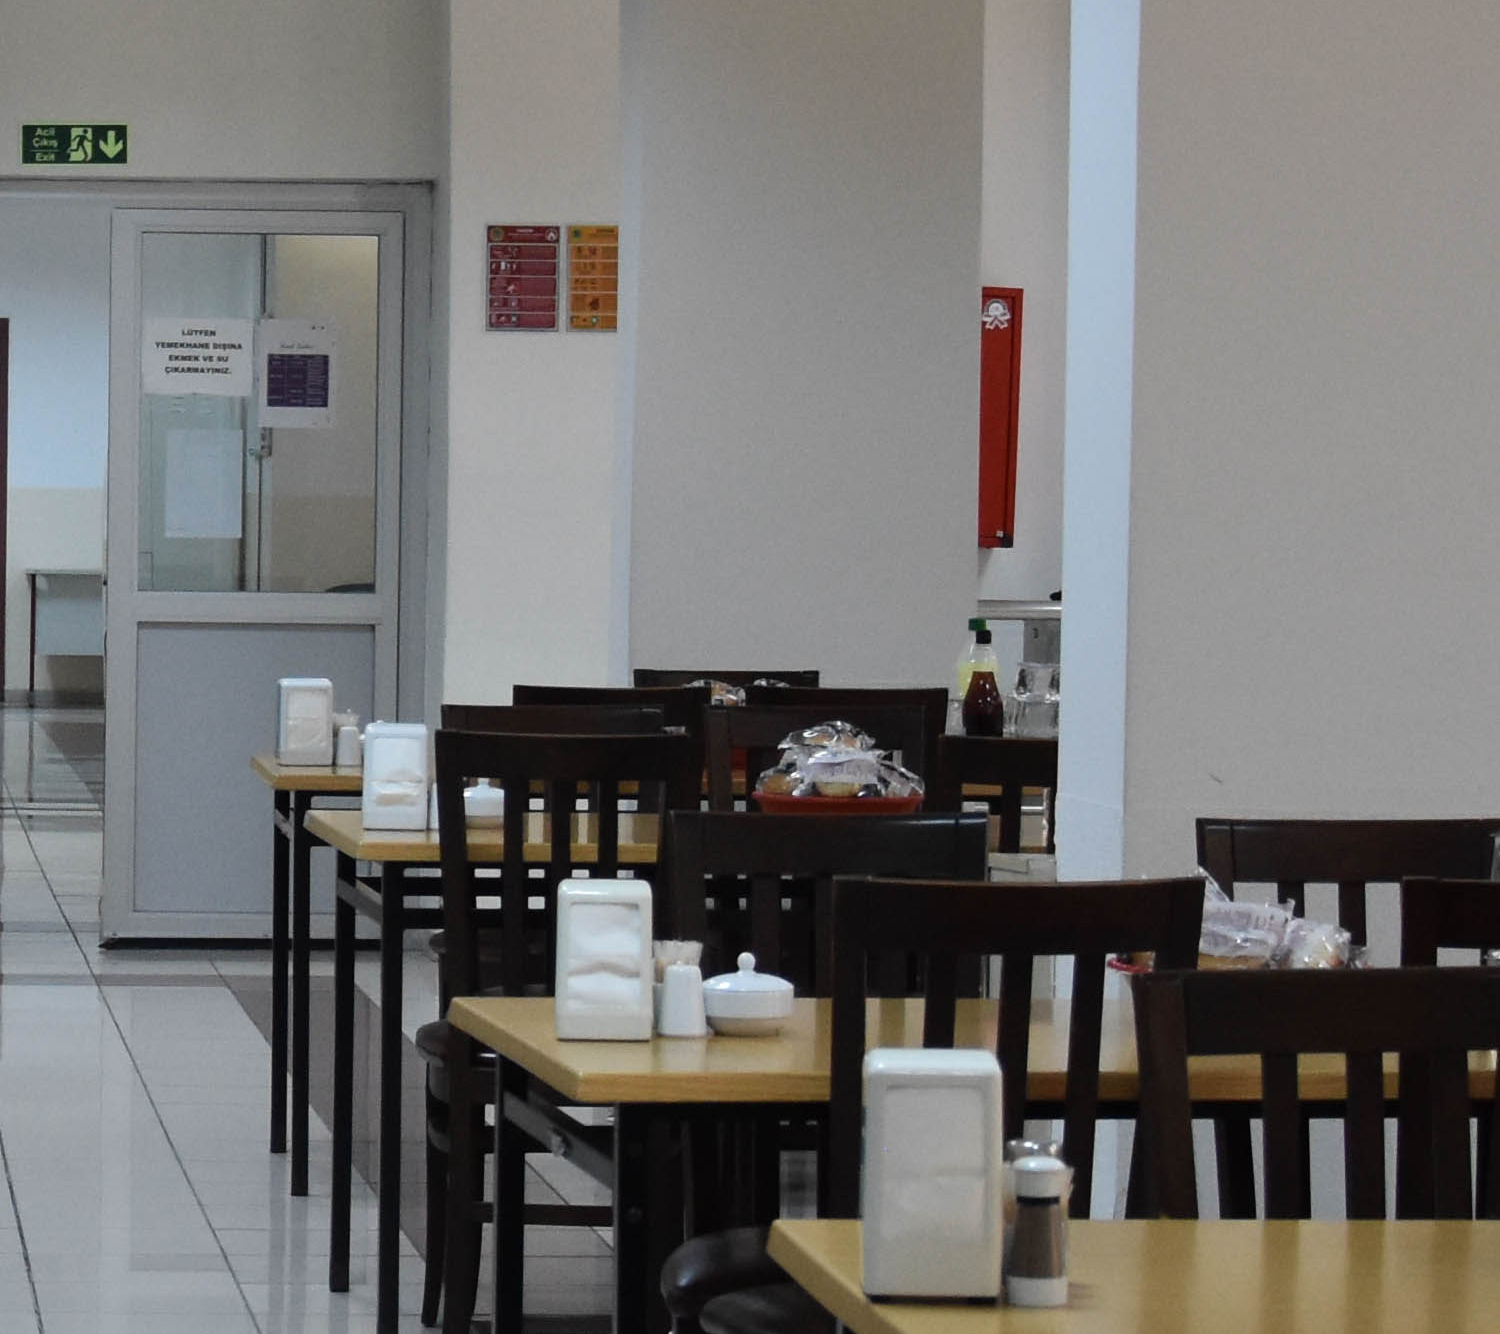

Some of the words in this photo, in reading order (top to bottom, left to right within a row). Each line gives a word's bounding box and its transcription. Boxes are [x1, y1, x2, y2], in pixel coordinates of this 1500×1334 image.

[35, 127, 56, 137] Acil
[32, 137, 58, 149] Çıkış
[35, 152, 56, 162] Exit
[181, 328, 216, 337] LÜTFEN
[155, 341, 210, 350] YEMEKHANE
[212, 342, 243, 352] DIŞINA
[168, 354, 200, 362] EKMEK
